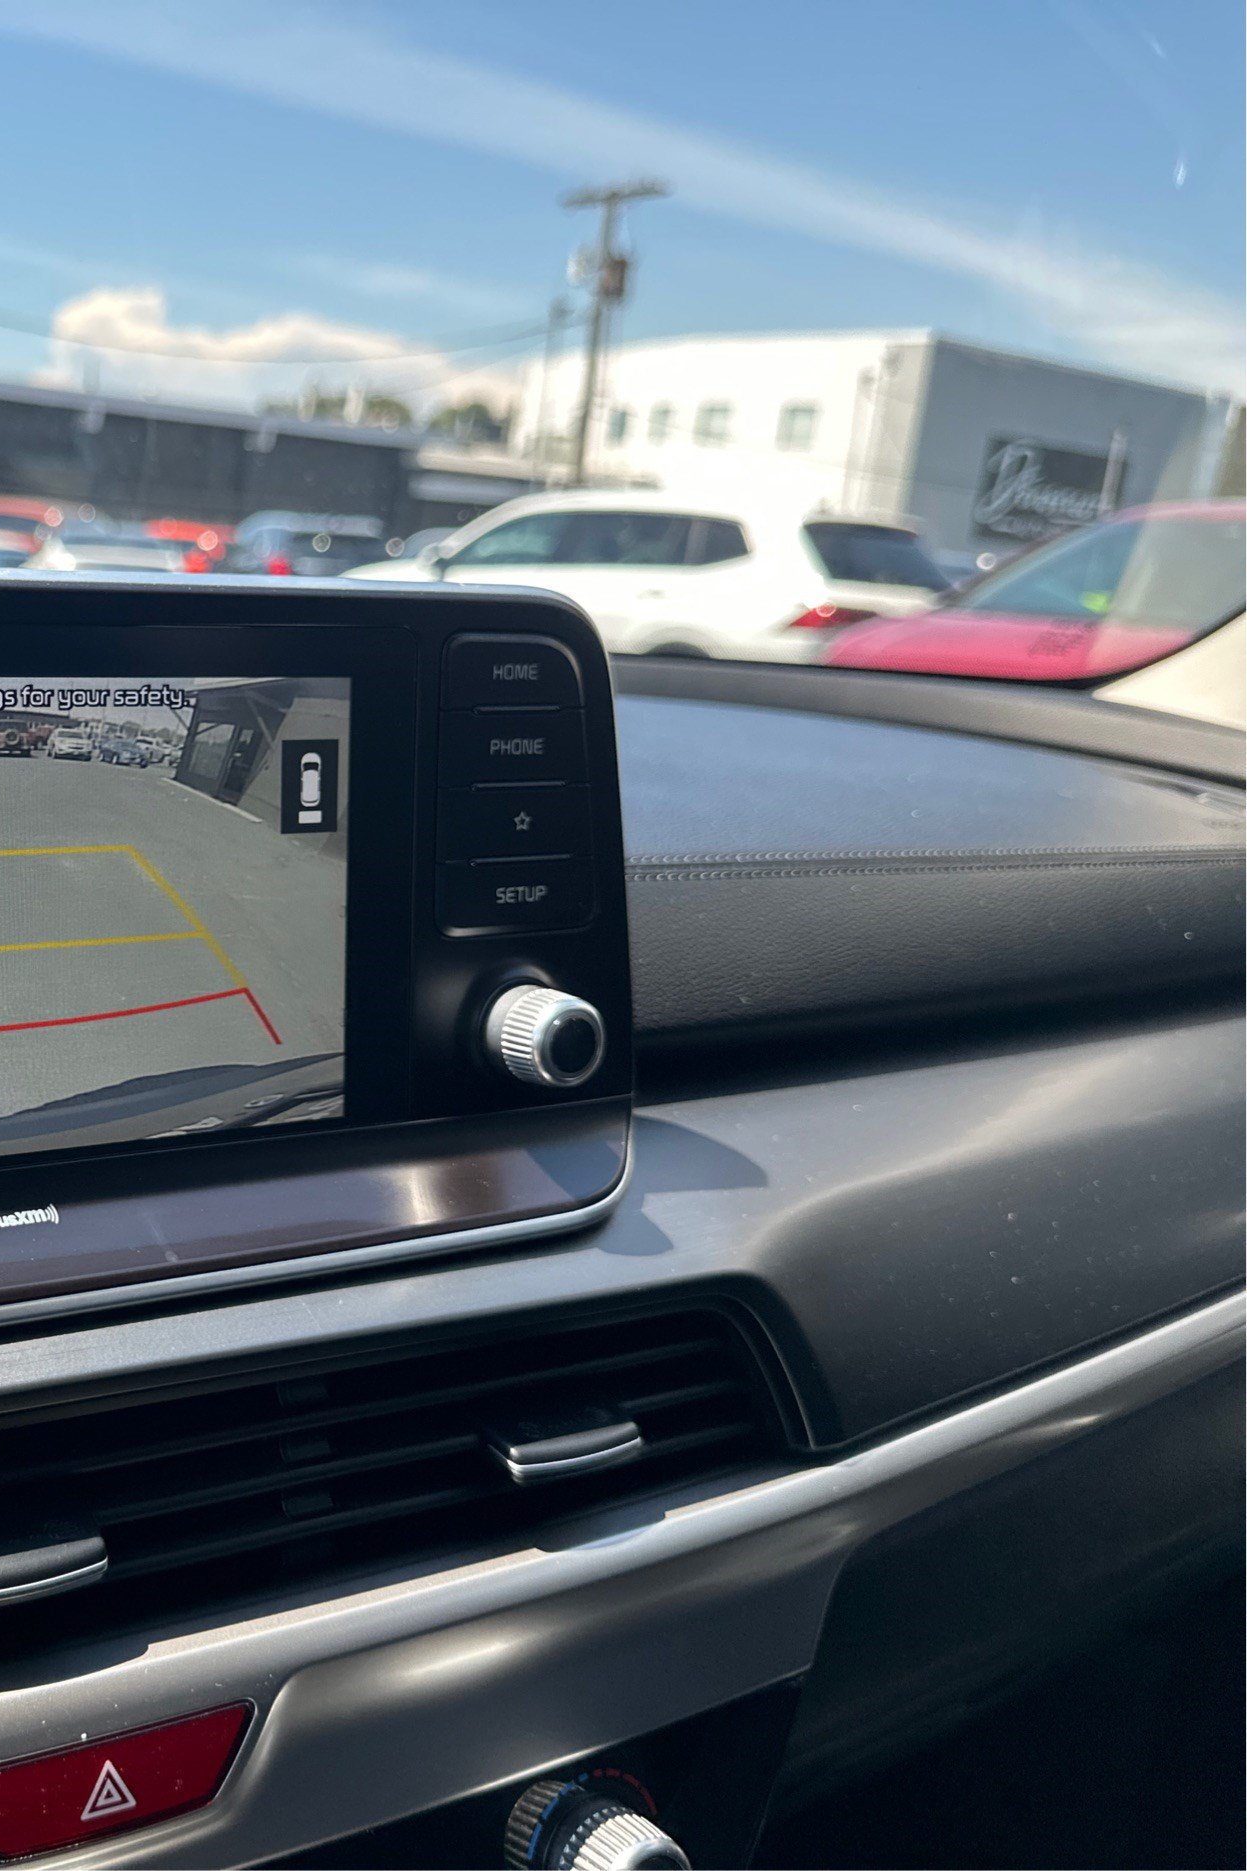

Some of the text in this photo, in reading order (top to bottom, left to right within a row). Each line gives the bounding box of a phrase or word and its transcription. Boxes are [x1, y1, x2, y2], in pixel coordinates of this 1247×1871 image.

[492, 664, 539, 681] HOME
[22, 686, 54, 707] for
[58, 690, 110, 709] your
[113, 686, 190, 709] safety.
[489, 738, 545, 755] PHONE
[496, 885, 548, 904] SETUP
